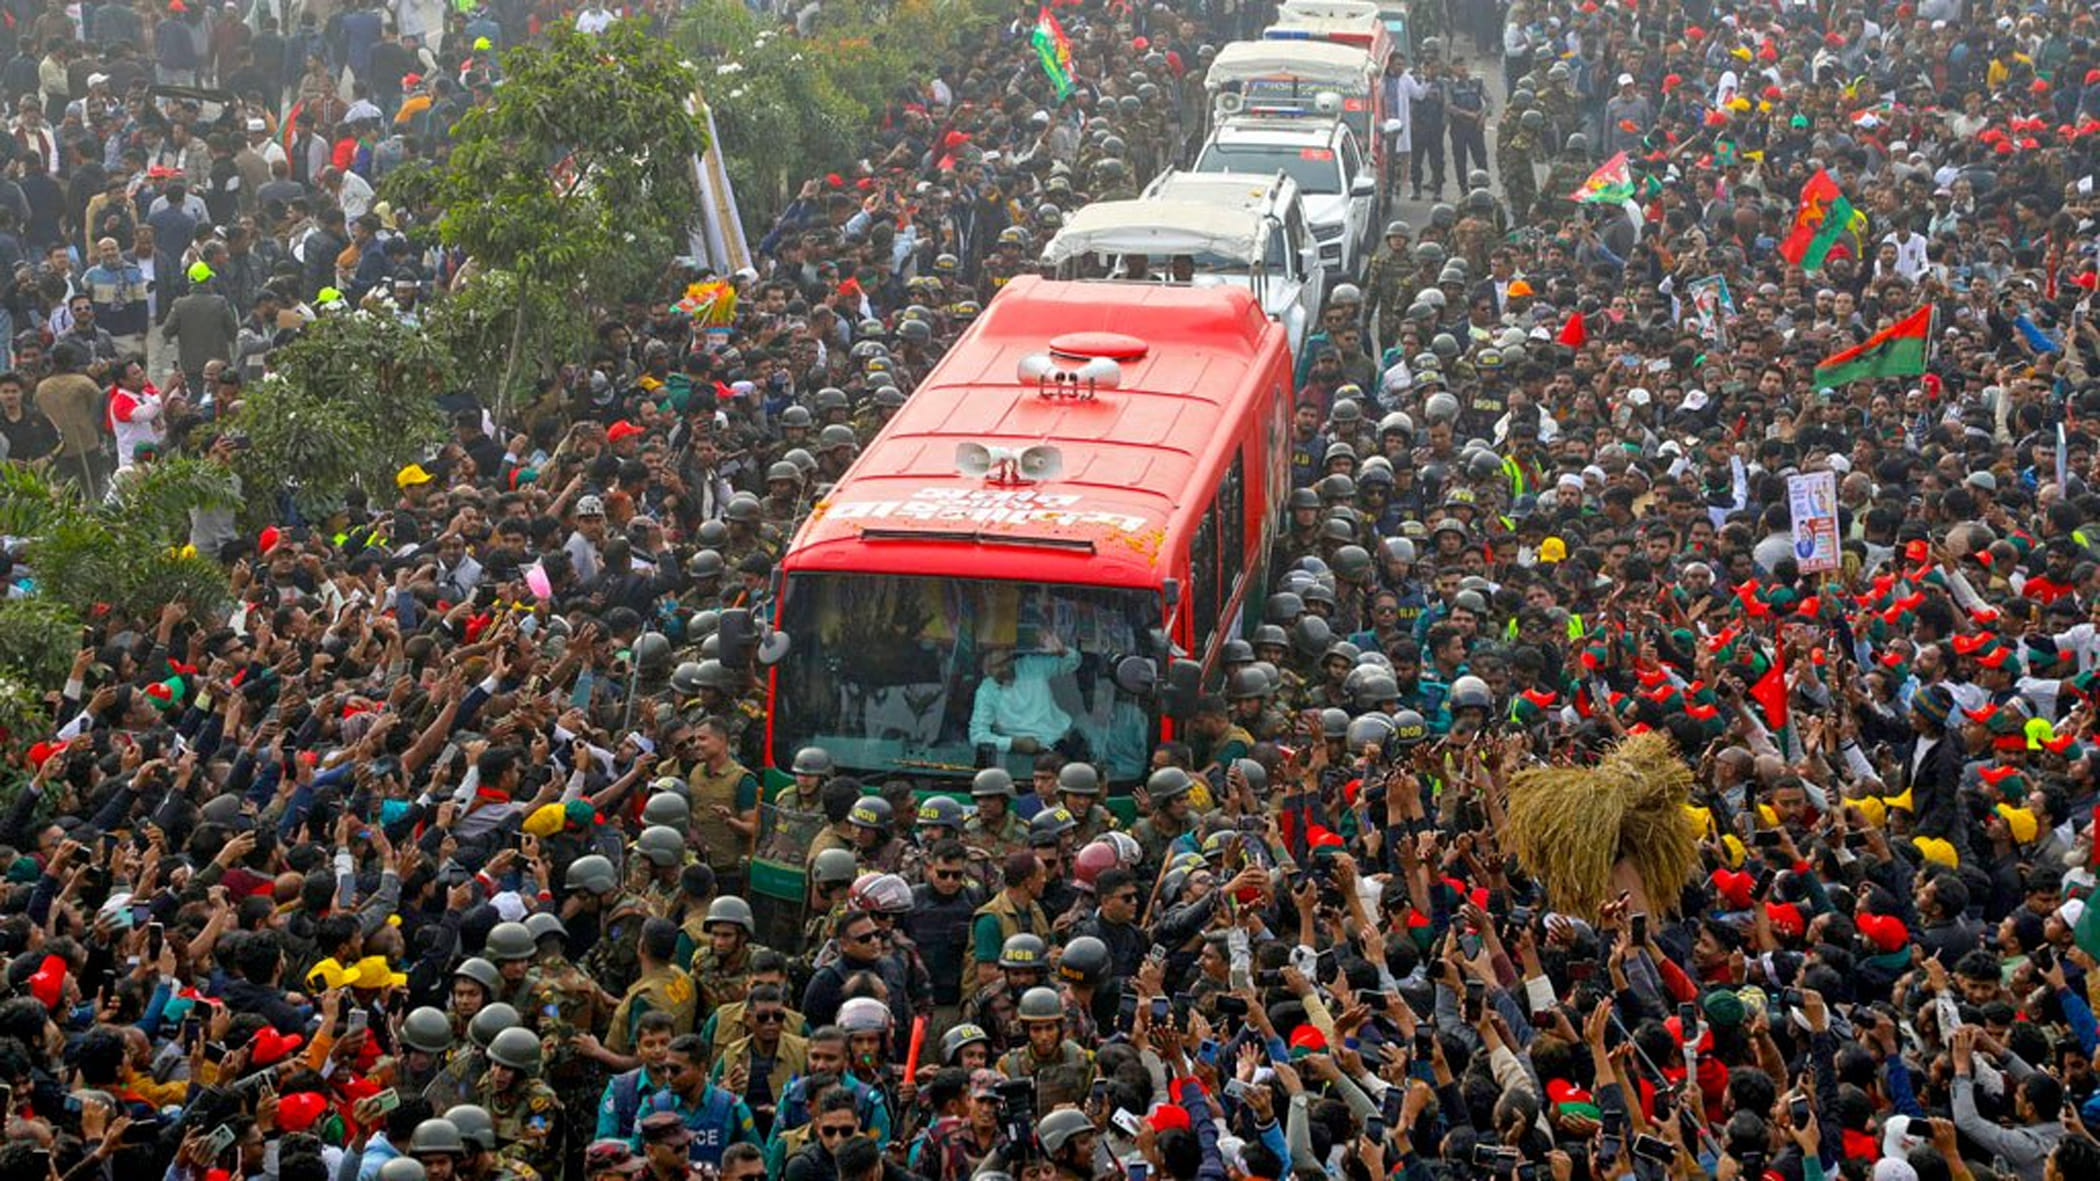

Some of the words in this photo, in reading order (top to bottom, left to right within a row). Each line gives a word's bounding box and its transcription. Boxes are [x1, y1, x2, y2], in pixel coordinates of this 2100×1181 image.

[1396, 608, 1417, 619] RA
[1400, 726, 1422, 736] BGB
[1004, 950, 1033, 961] BGB
